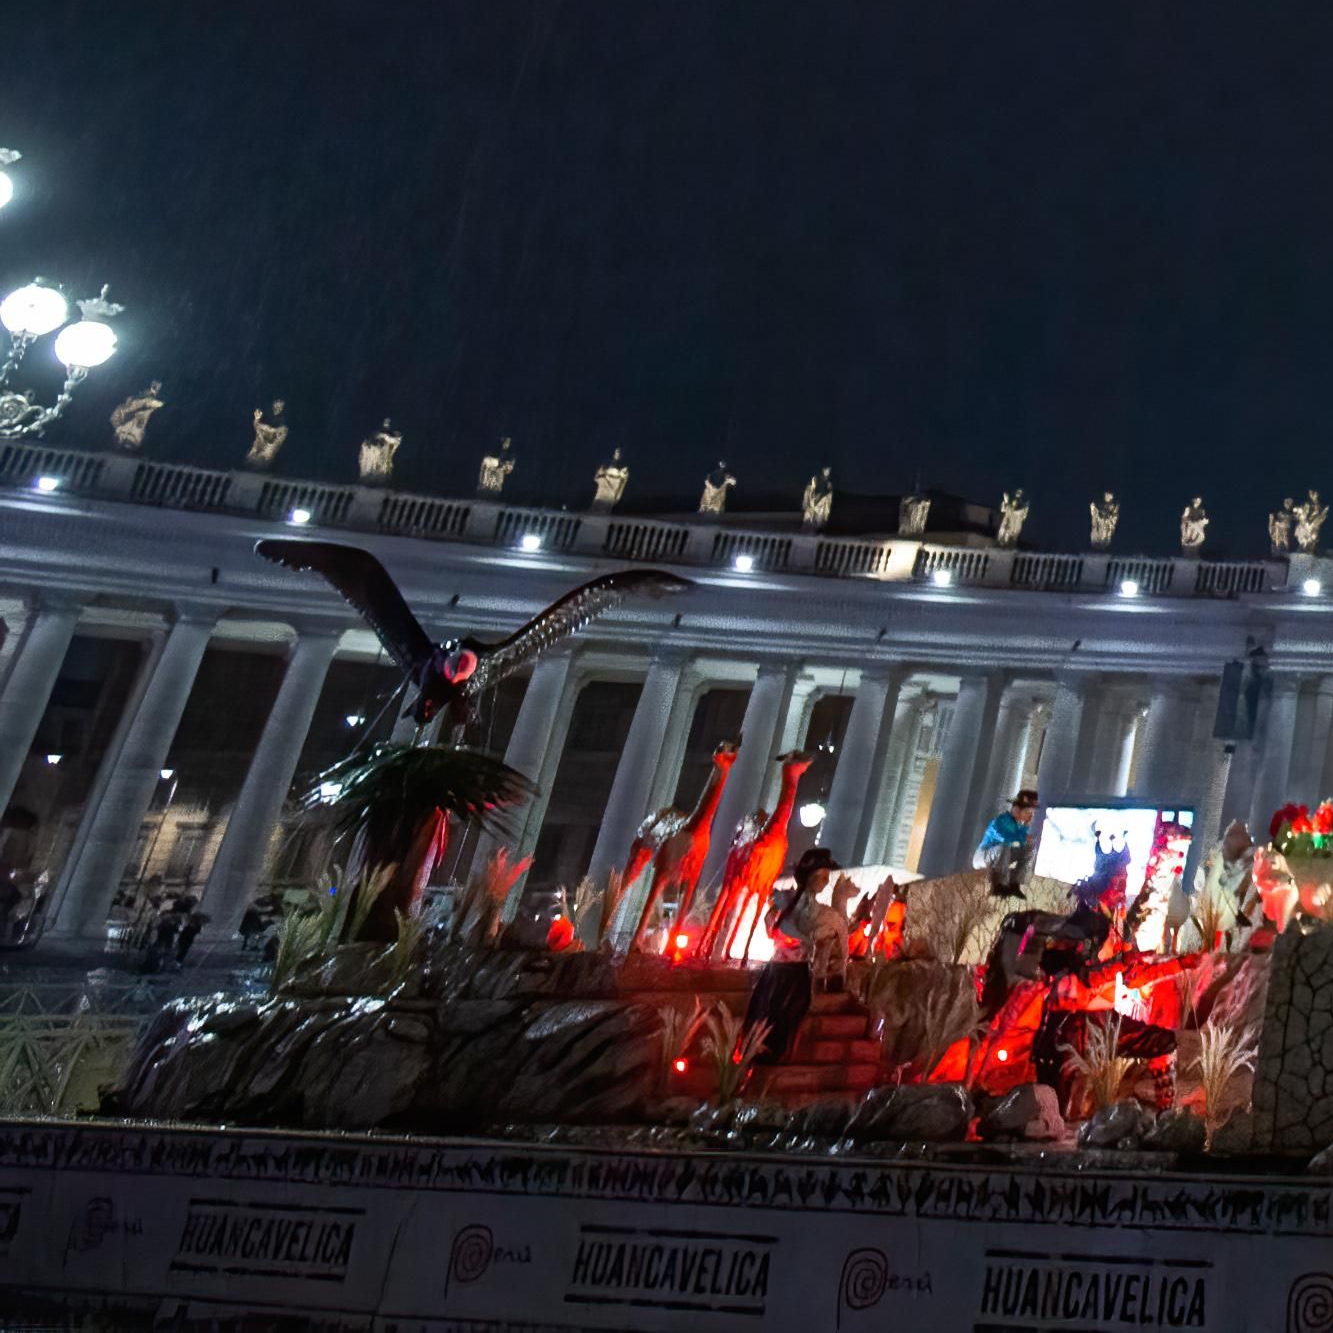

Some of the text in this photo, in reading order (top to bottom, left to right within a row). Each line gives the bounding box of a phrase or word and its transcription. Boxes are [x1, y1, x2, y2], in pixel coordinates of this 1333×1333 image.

[178, 1213, 356, 1266] HUANCAVELICA
[572, 1241, 771, 1297] HUANCAVELICA
[981, 1266, 1207, 1327] HUANCAVELICA
